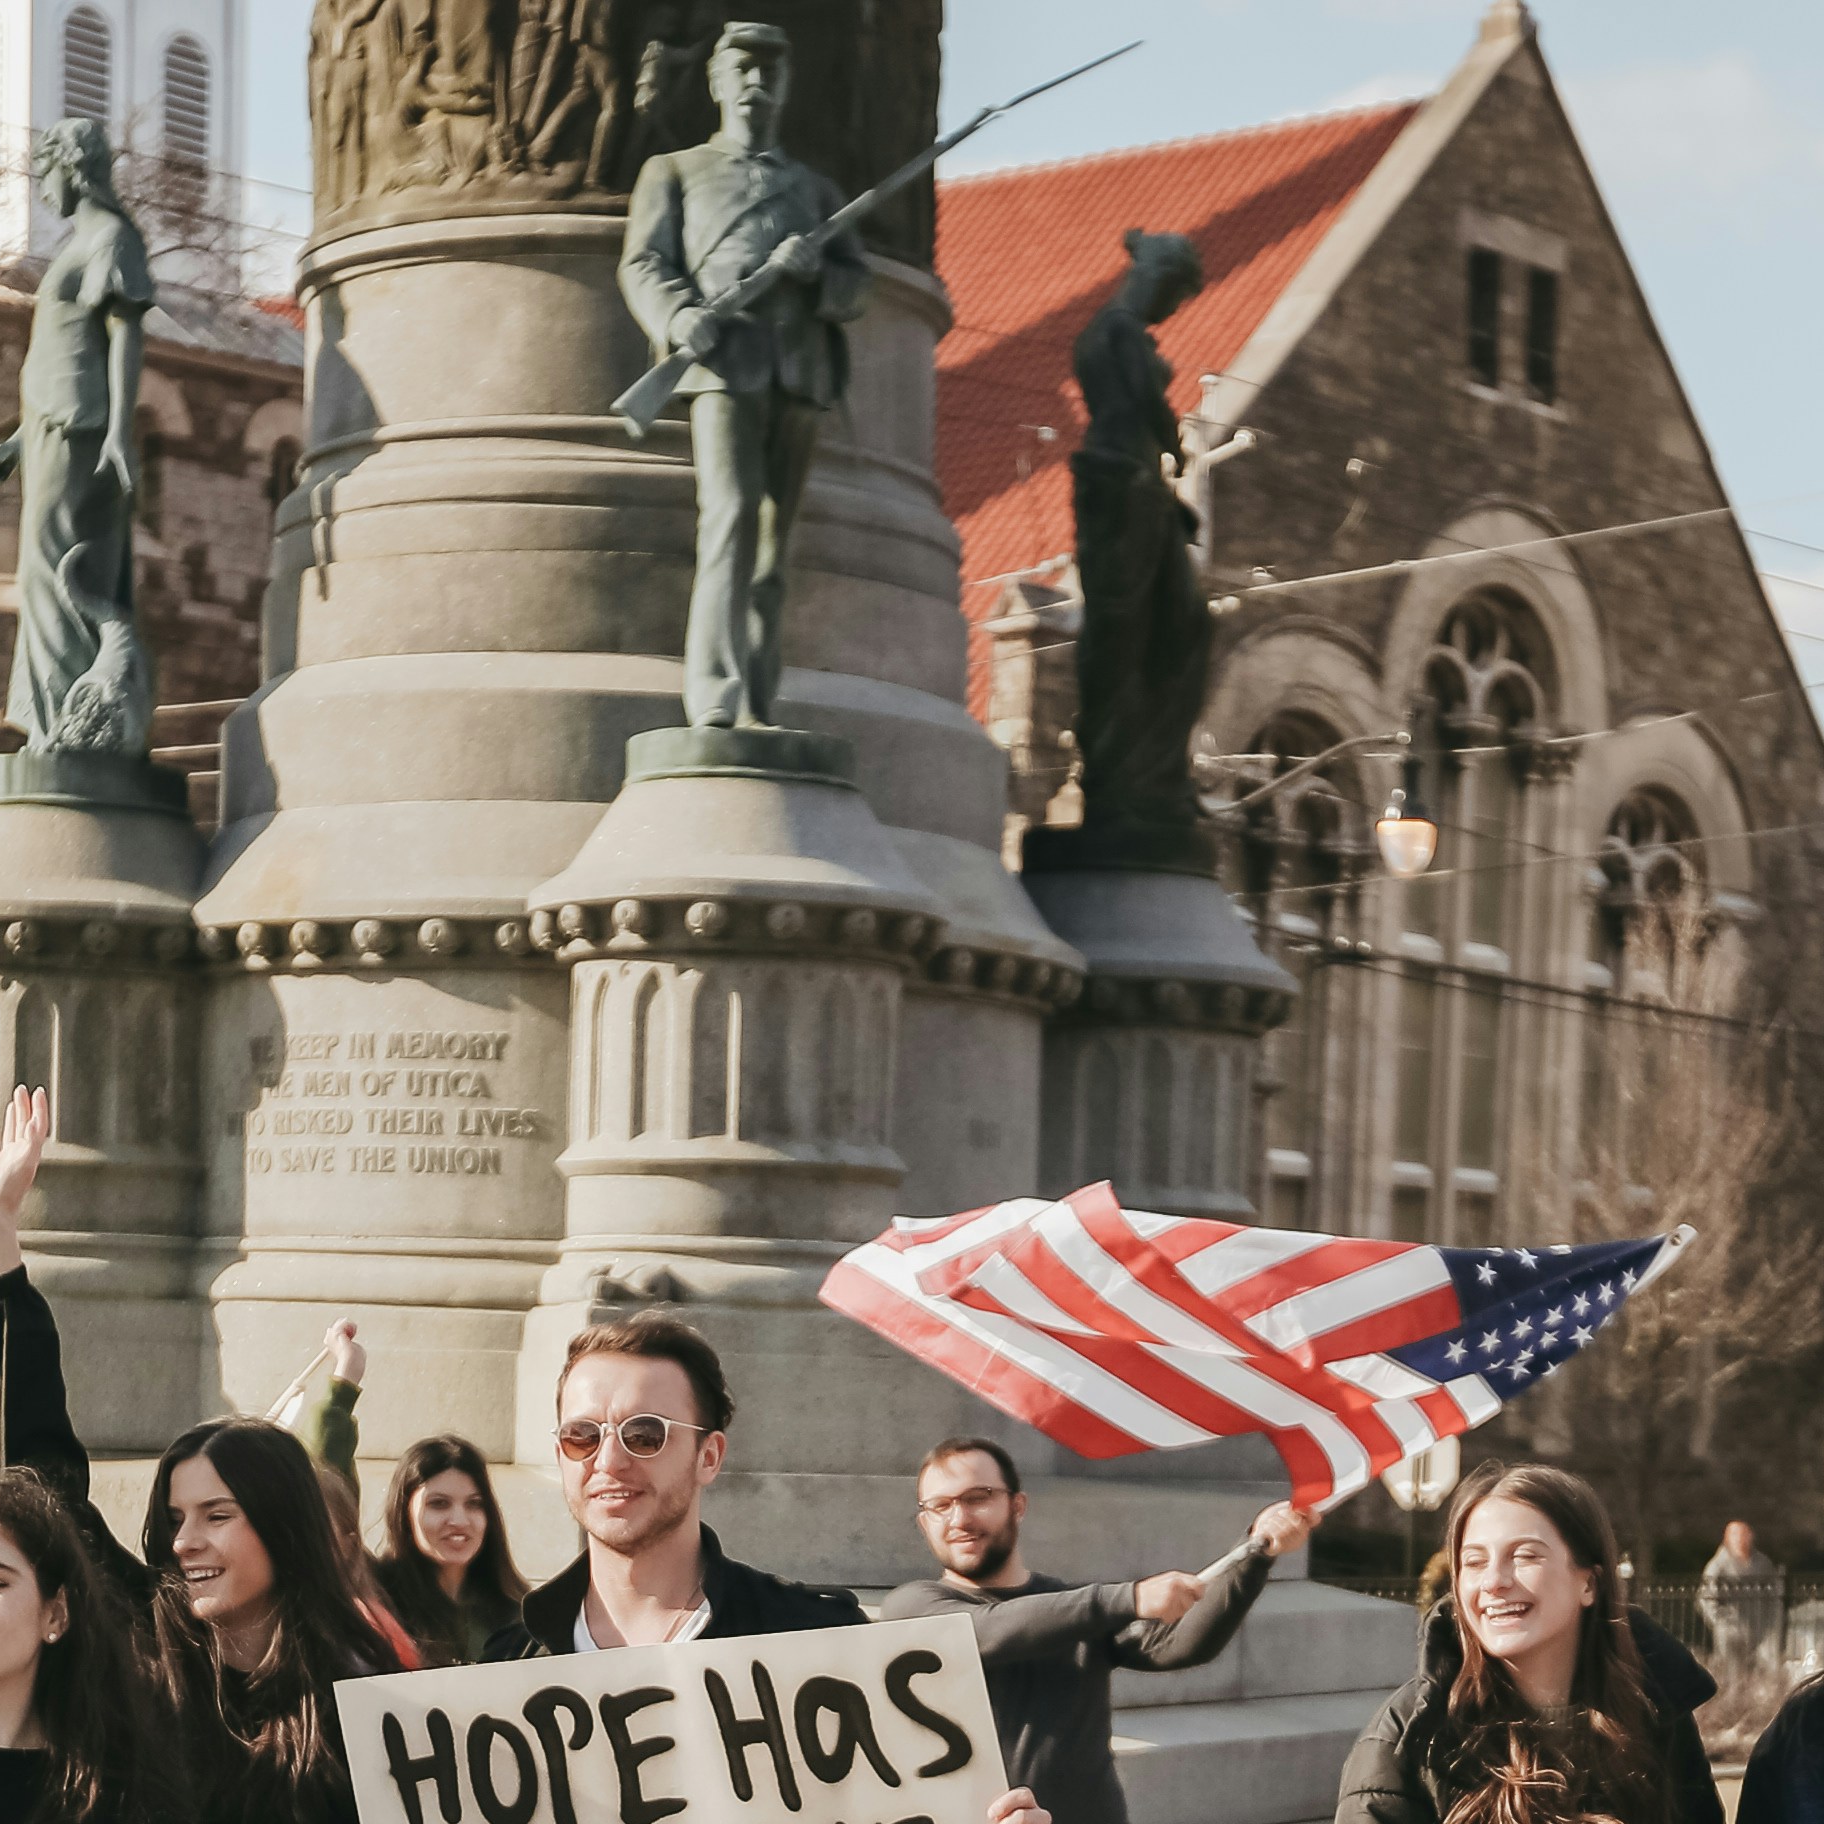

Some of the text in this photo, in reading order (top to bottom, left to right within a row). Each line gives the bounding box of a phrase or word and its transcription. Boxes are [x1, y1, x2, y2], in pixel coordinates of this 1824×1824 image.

[347, 1031, 375, 1059] IN
[385, 1031, 510, 1060] MEMORY
[302, 1070, 351, 1097] MEN
[360, 1069, 397, 1097] OF
[403, 1069, 492, 1098] UTICA
[274, 1108, 353, 1135] RISKED
[365, 1106, 444, 1135] THEIR
[456, 1107, 540, 1136] LIVES
[281, 1146, 335, 1173] SAVE
[347, 1146, 396, 1173] THE
[407, 1146, 502, 1174] UNION
